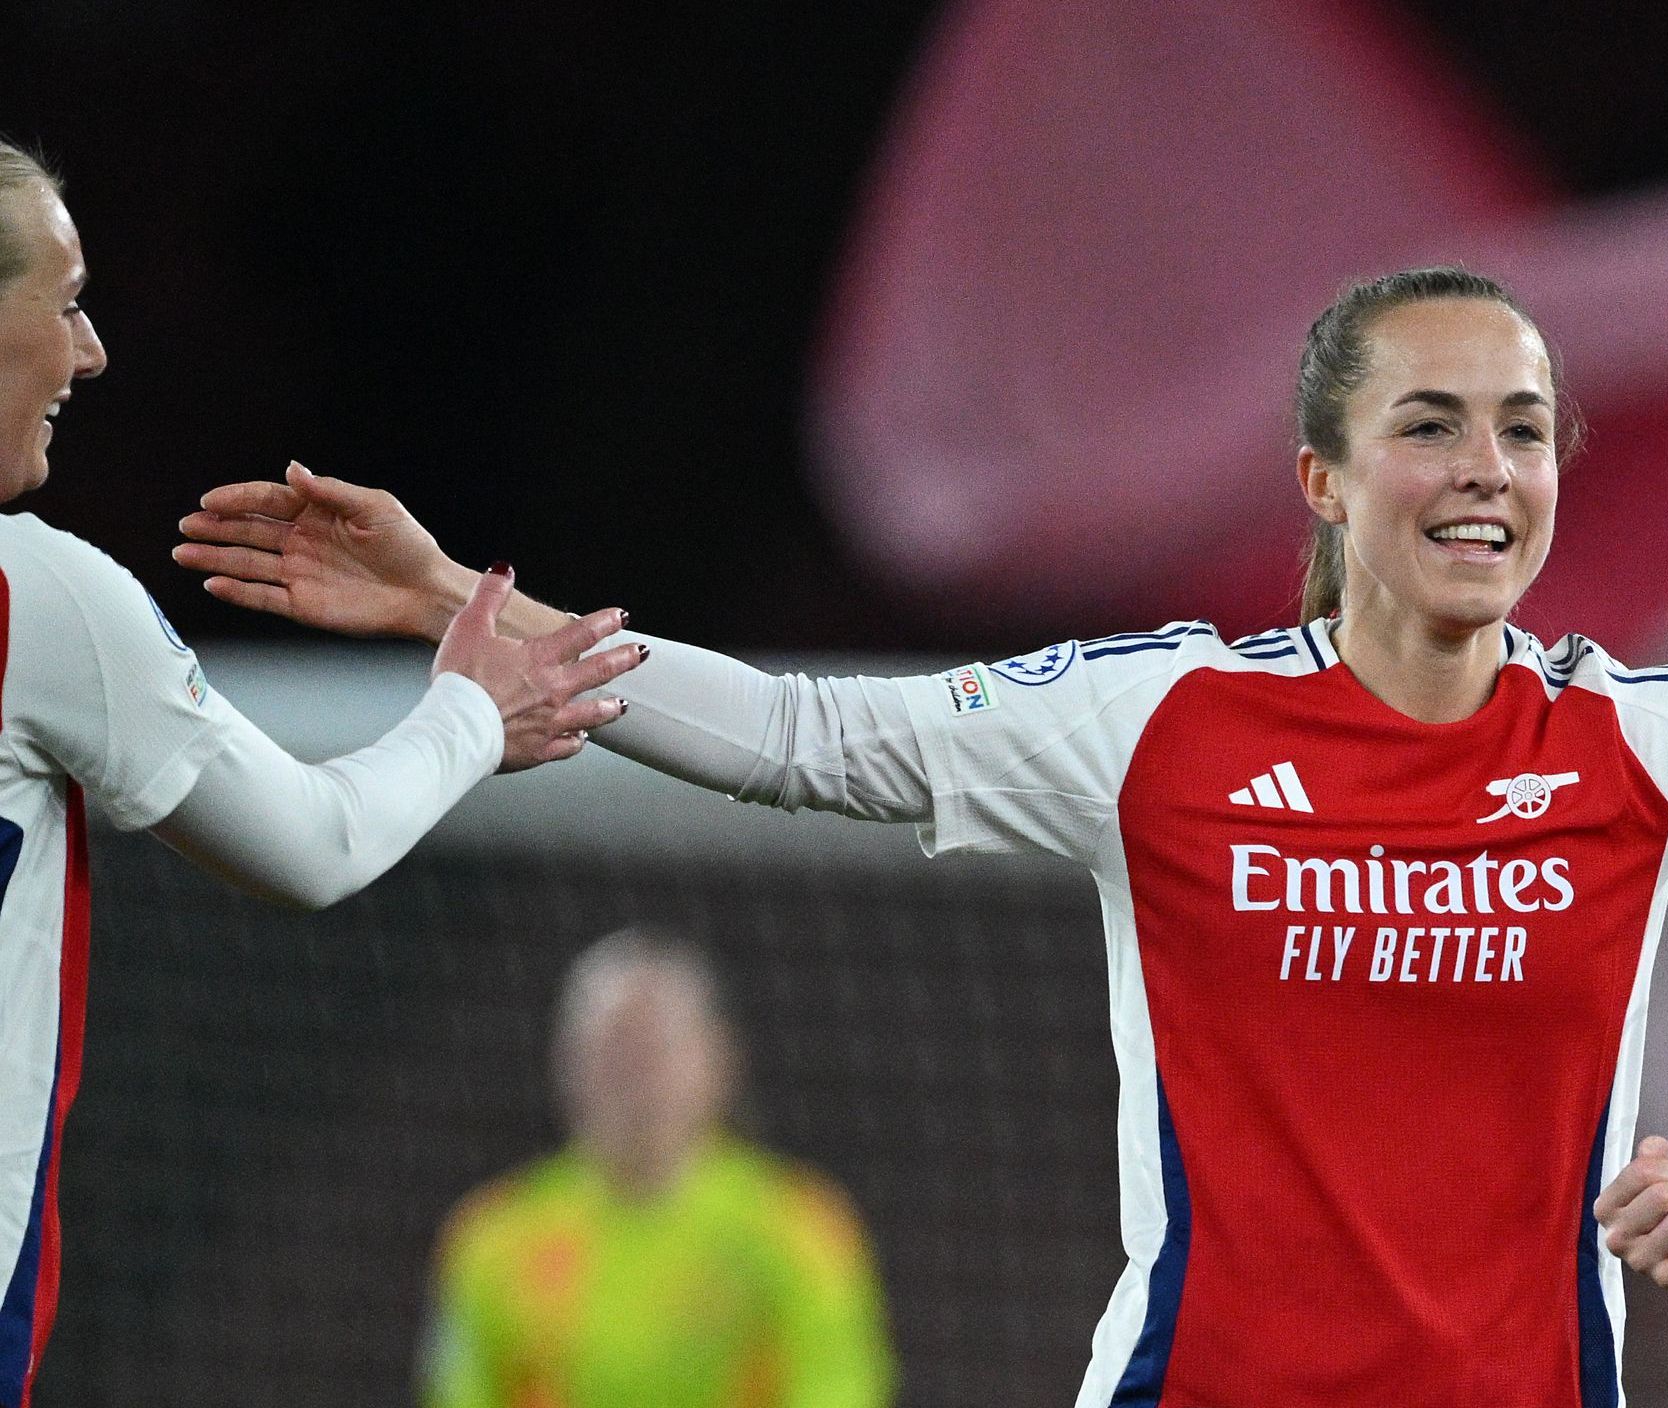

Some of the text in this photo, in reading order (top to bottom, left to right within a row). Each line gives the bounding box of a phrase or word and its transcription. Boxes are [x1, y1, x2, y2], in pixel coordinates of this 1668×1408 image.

[1230, 844, 1574, 914] Emirates
[1279, 925, 1527, 982] FLY BETTER
